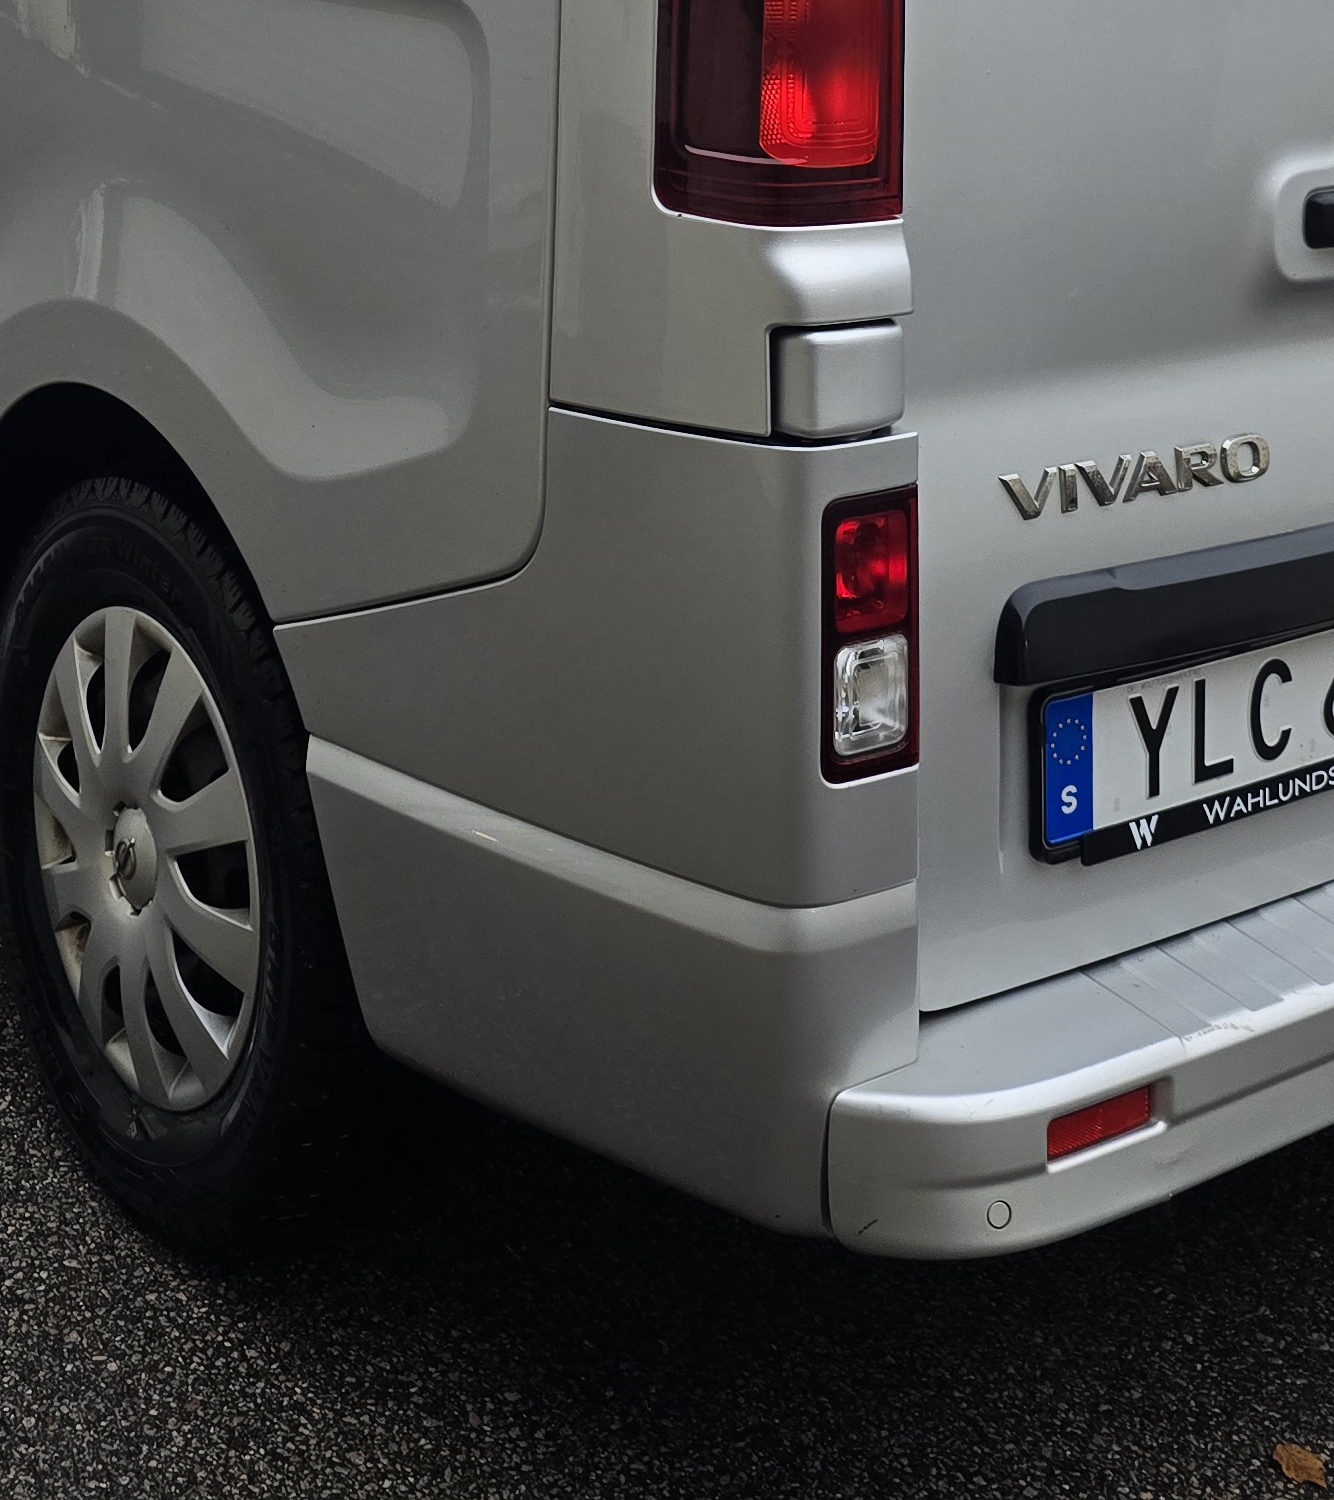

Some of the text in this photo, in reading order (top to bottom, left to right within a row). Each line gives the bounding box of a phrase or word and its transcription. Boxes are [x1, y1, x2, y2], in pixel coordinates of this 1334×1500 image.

[997, 432, 1271, 522] VIVARO
[1129, 658, 1292, 798] YLC
[1060, 784, 1079, 816] S
